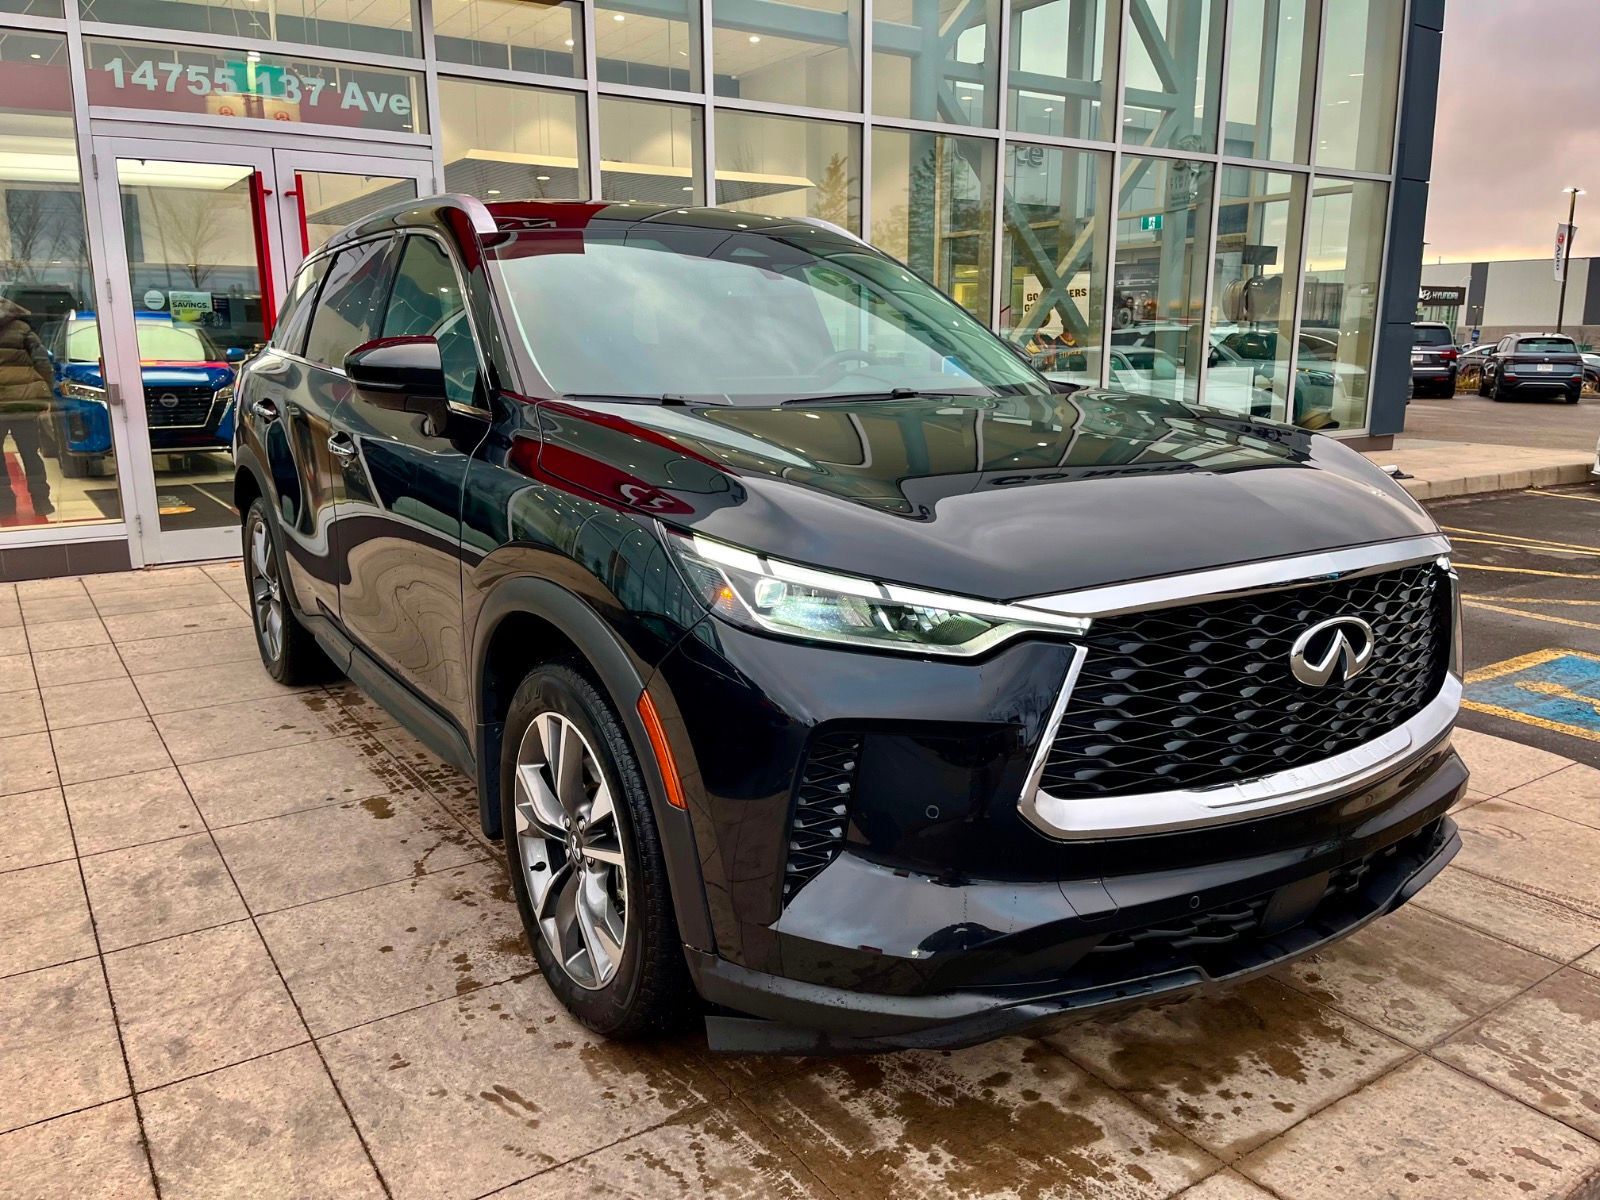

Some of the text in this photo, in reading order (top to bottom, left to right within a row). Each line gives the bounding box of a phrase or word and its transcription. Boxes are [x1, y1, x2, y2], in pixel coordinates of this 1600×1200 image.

[104, 57, 411, 116] 14755 137 Ave
[1026, 292, 1039, 302] GO
